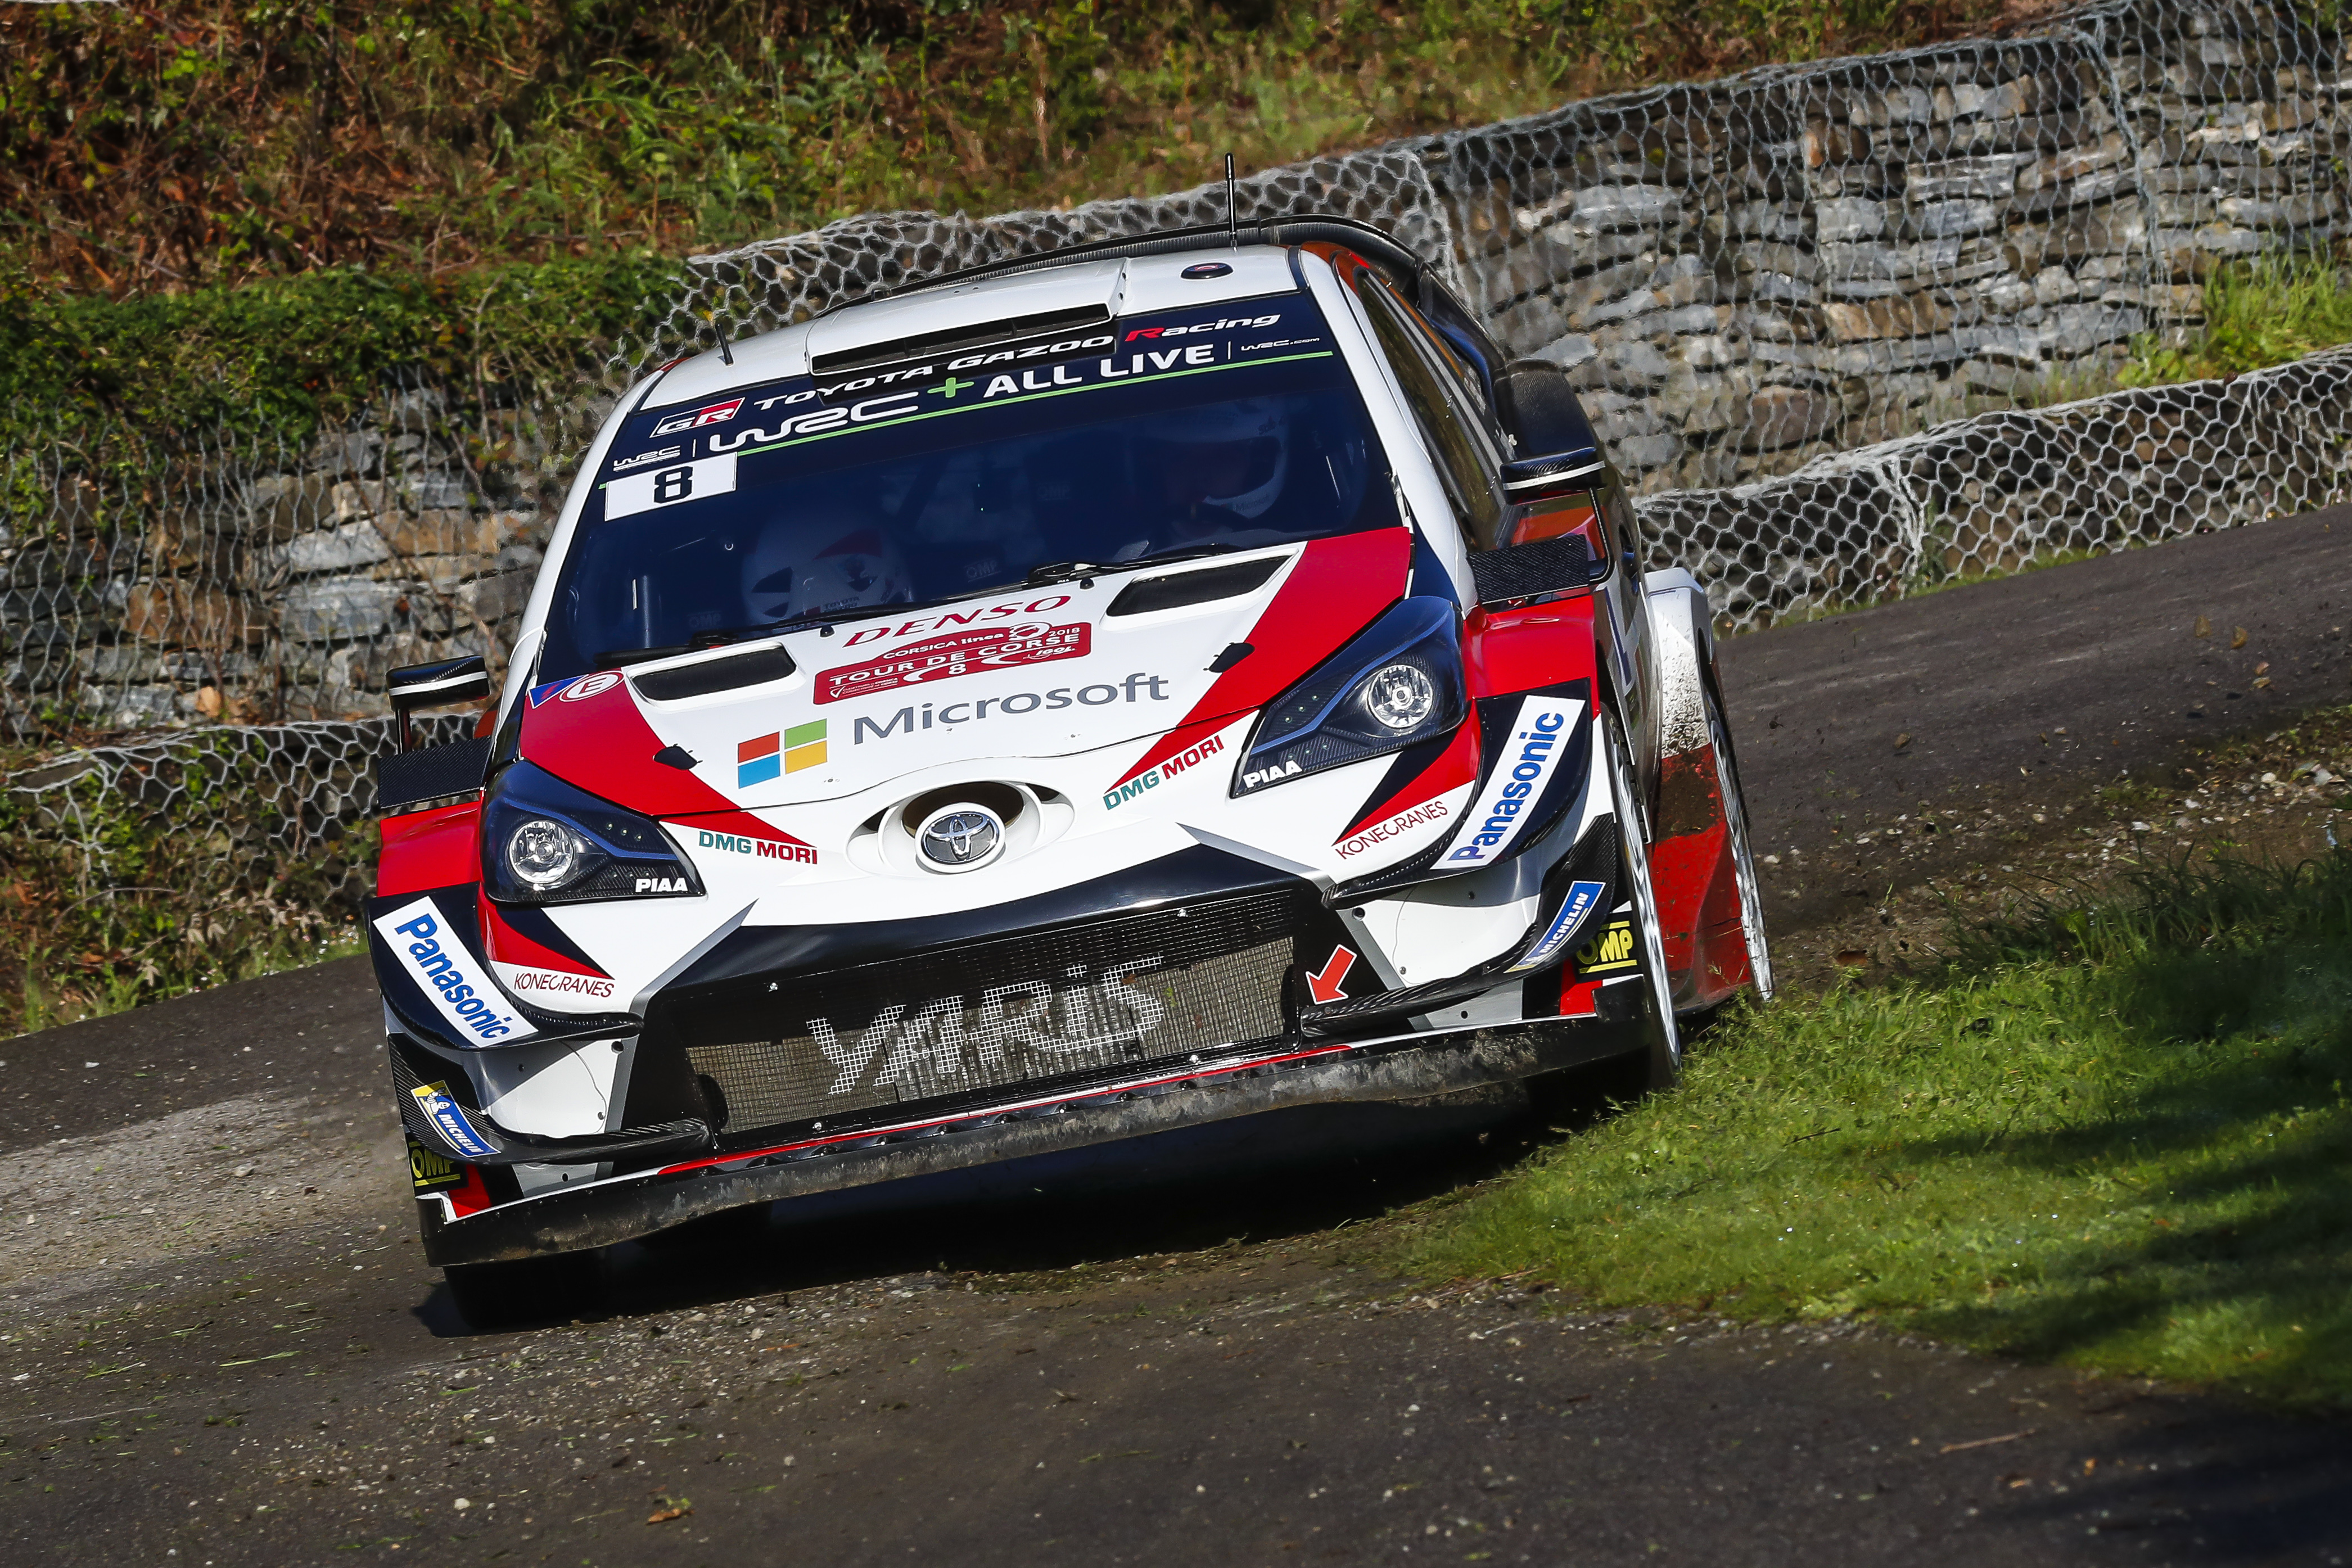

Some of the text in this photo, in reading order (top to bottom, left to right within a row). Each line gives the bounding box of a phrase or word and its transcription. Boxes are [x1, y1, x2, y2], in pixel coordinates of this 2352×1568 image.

[654, 313, 1281, 434] GR TOYOTA GAZOO Racing
[983, 364, 1083, 398] ALL
[1099, 344, 1215, 379] LIVE
[653, 465, 694, 504] 8
[841, 594, 1072, 648] DENSO
[1048, 627, 1080, 637] 2018
[829, 633, 1080, 685] TOUR DE CORSE
[883, 632, 1004, 659] CORSICA linea
[948, 663, 967, 675] 8
[854, 672, 1170, 745] Microsoft
[1103, 734, 1225, 811] DMG MORI
[1243, 760, 1303, 789] PIAA
[1447, 711, 1565, 862] Panasonic
[698, 830, 818, 865] DMG MORI
[1335, 801, 1449, 860] KONECRANES
[635, 878, 688, 893] PIAA
[1538, 892, 1589, 954] MICHELIN
[1576, 929, 1633, 965] OMP
[394, 912, 512, 1039] Panasonic
[513, 973, 615, 998] KONECRANES
[437, 1114, 484, 1153] MICHELIN
